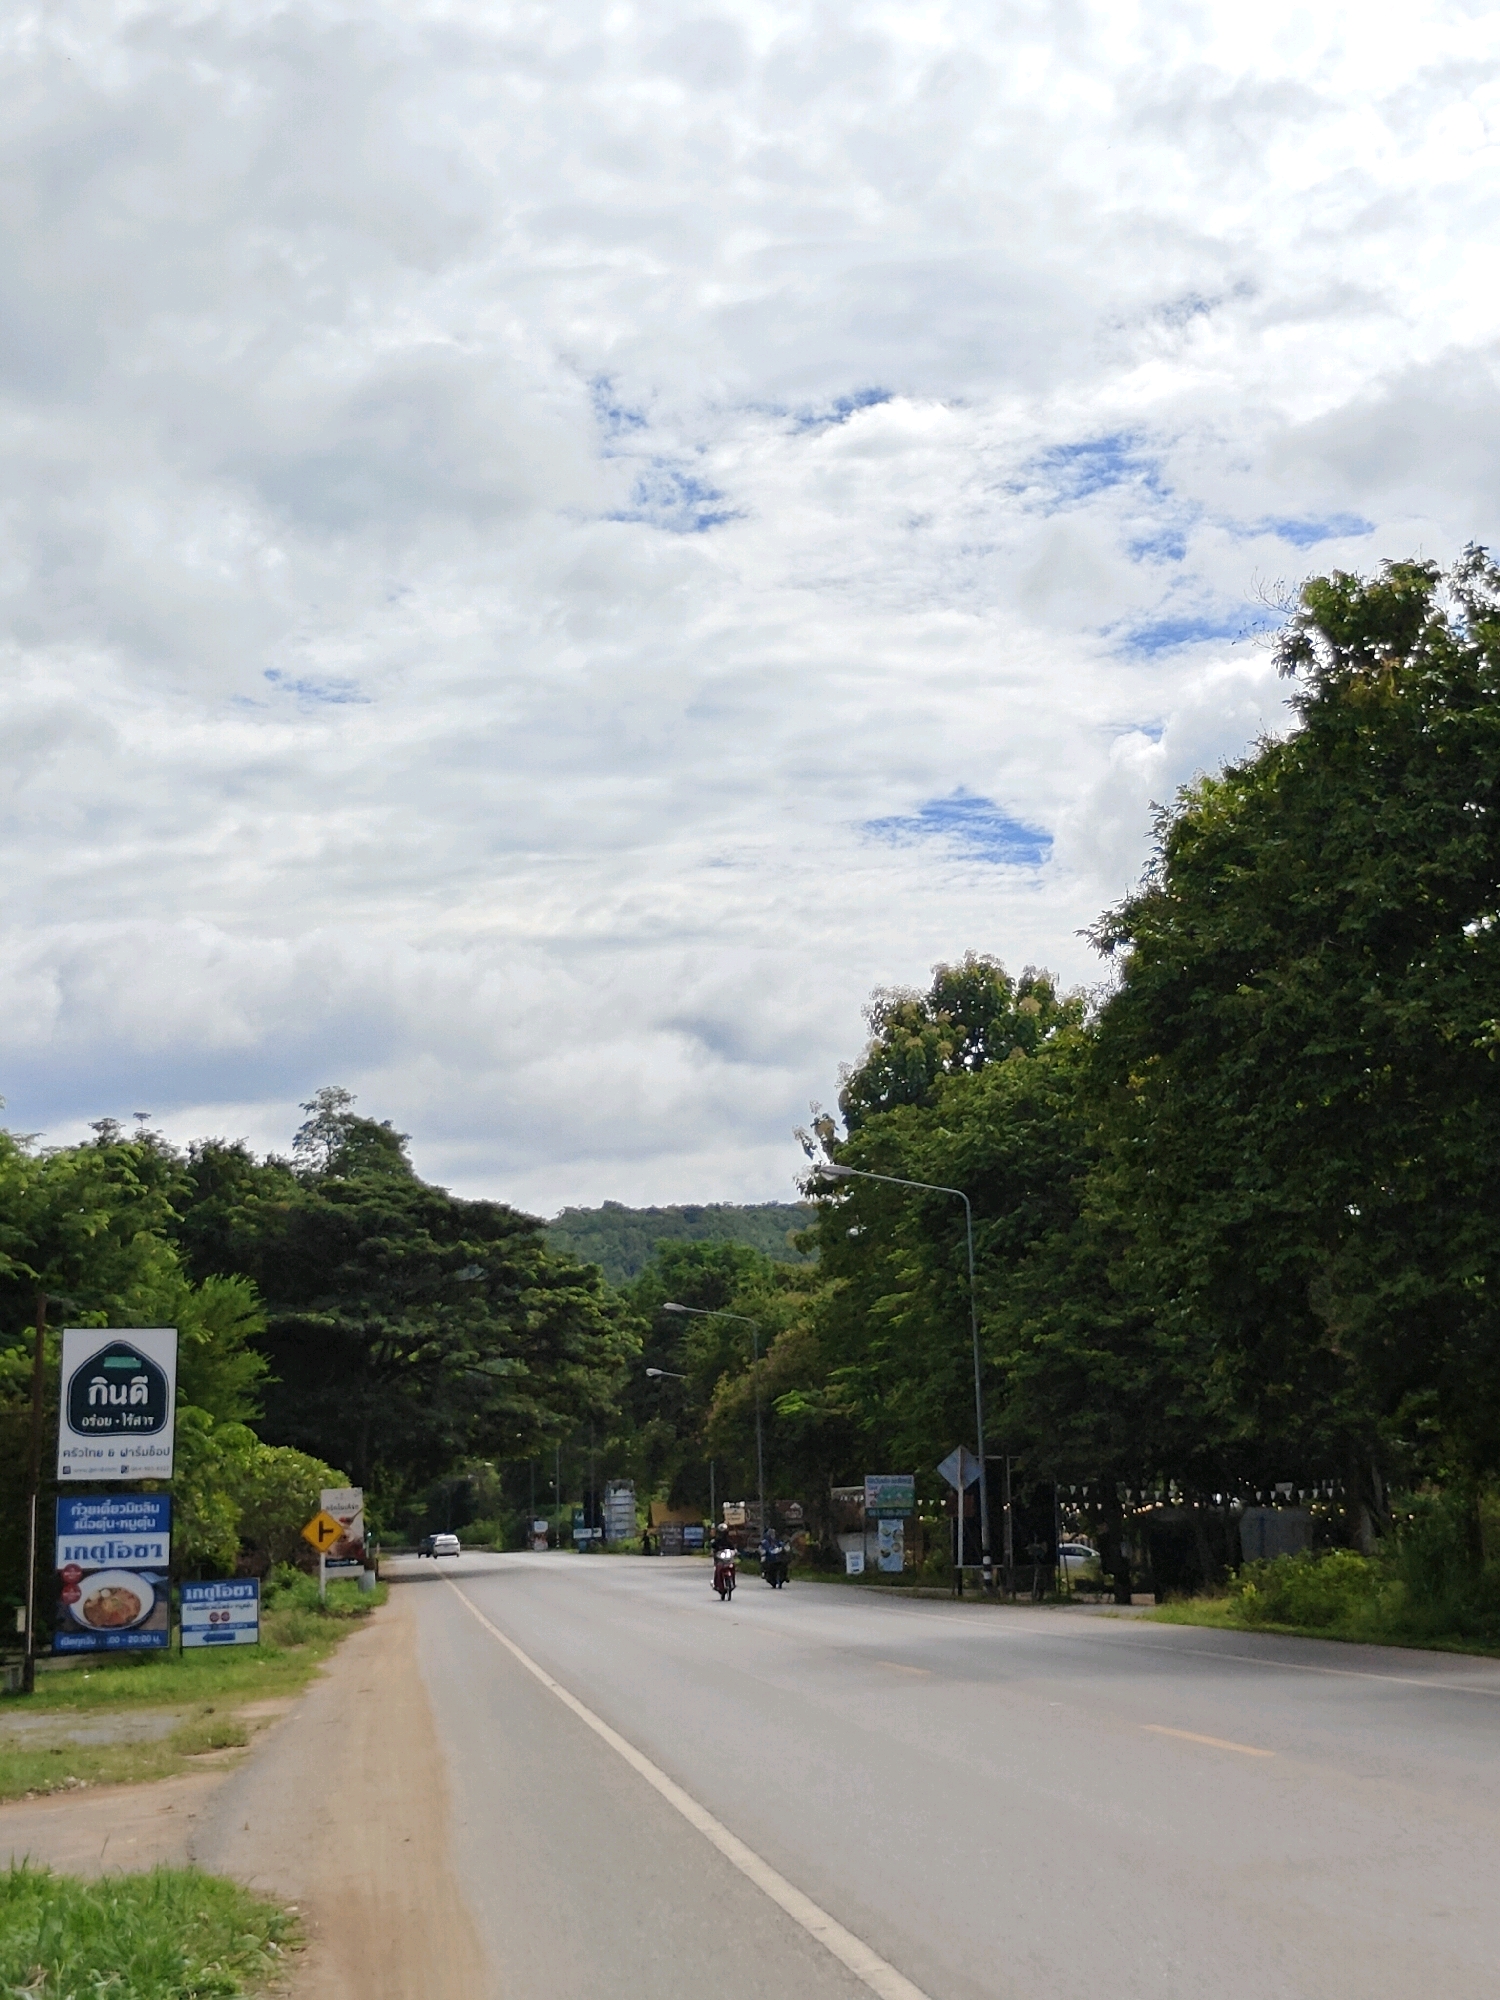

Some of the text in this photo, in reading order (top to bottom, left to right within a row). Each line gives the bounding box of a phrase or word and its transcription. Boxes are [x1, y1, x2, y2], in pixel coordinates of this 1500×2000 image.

[88, 1375, 149, 1406] กินดี
[81, 1413, 112, 1427] อร่อย
[63, 1446, 104, 1458] ครัวไทย
